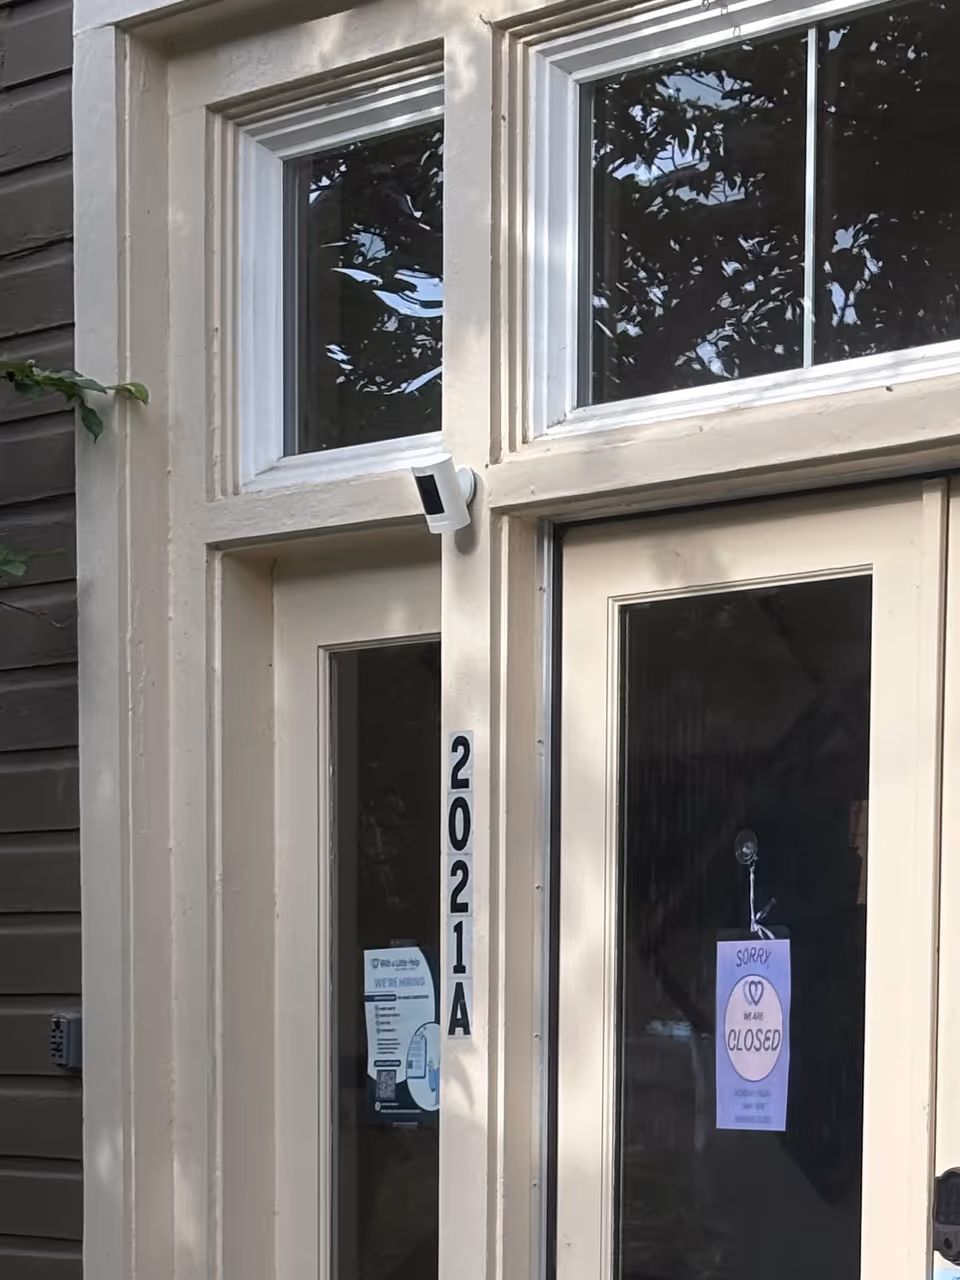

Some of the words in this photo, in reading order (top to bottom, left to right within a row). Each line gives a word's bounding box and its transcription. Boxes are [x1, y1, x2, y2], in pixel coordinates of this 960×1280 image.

[448, 735, 471, 1036] 2021A
[743, 1011, 752, 1021] WE
[752, 1011, 764, 1021] ARE
[727, 1028, 781, 1052] CLOSED
